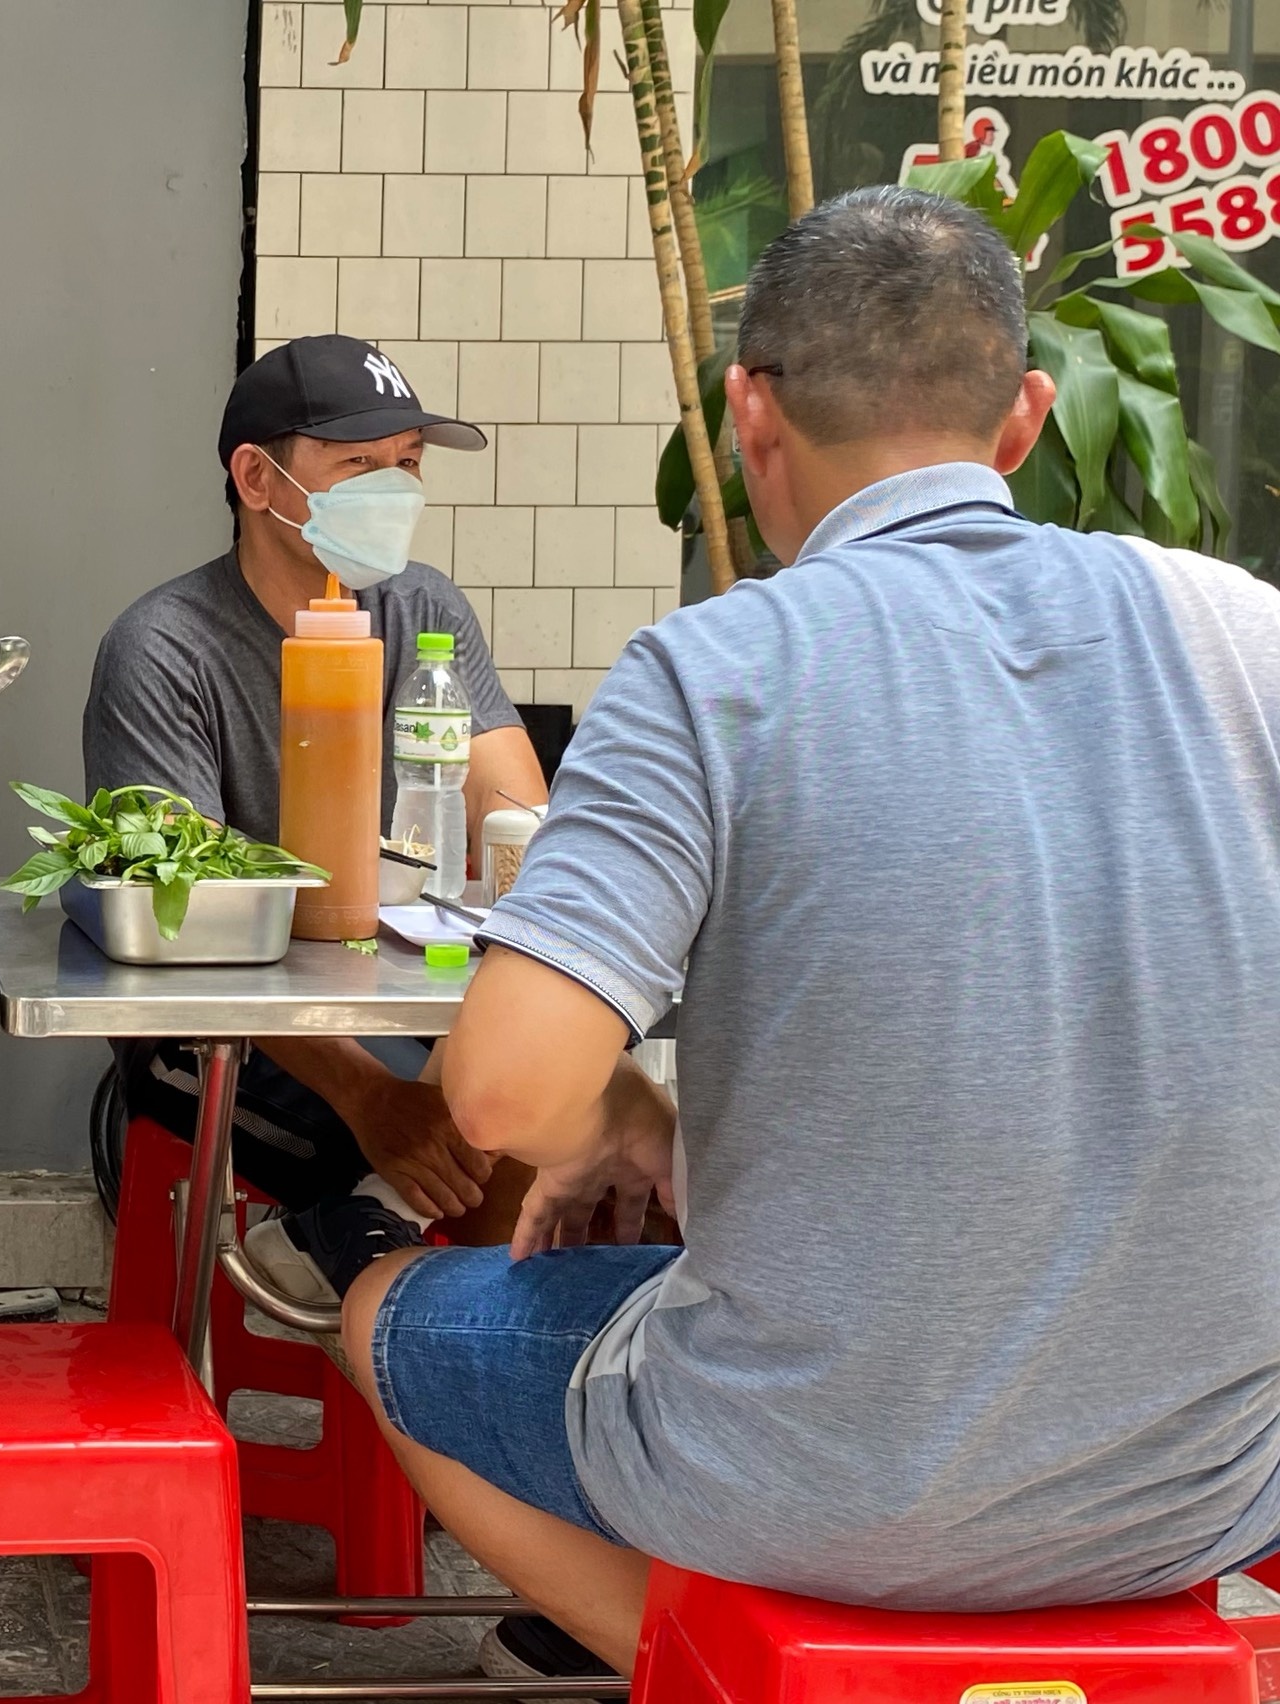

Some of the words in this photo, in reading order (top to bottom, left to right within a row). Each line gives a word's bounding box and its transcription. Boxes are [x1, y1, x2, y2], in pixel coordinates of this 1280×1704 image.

[871, 52, 911, 83] và
[920, 50, 1019, 85] niều
[1027, 56, 1106, 87] món
[1104, 101, 1280, 197] 1800
